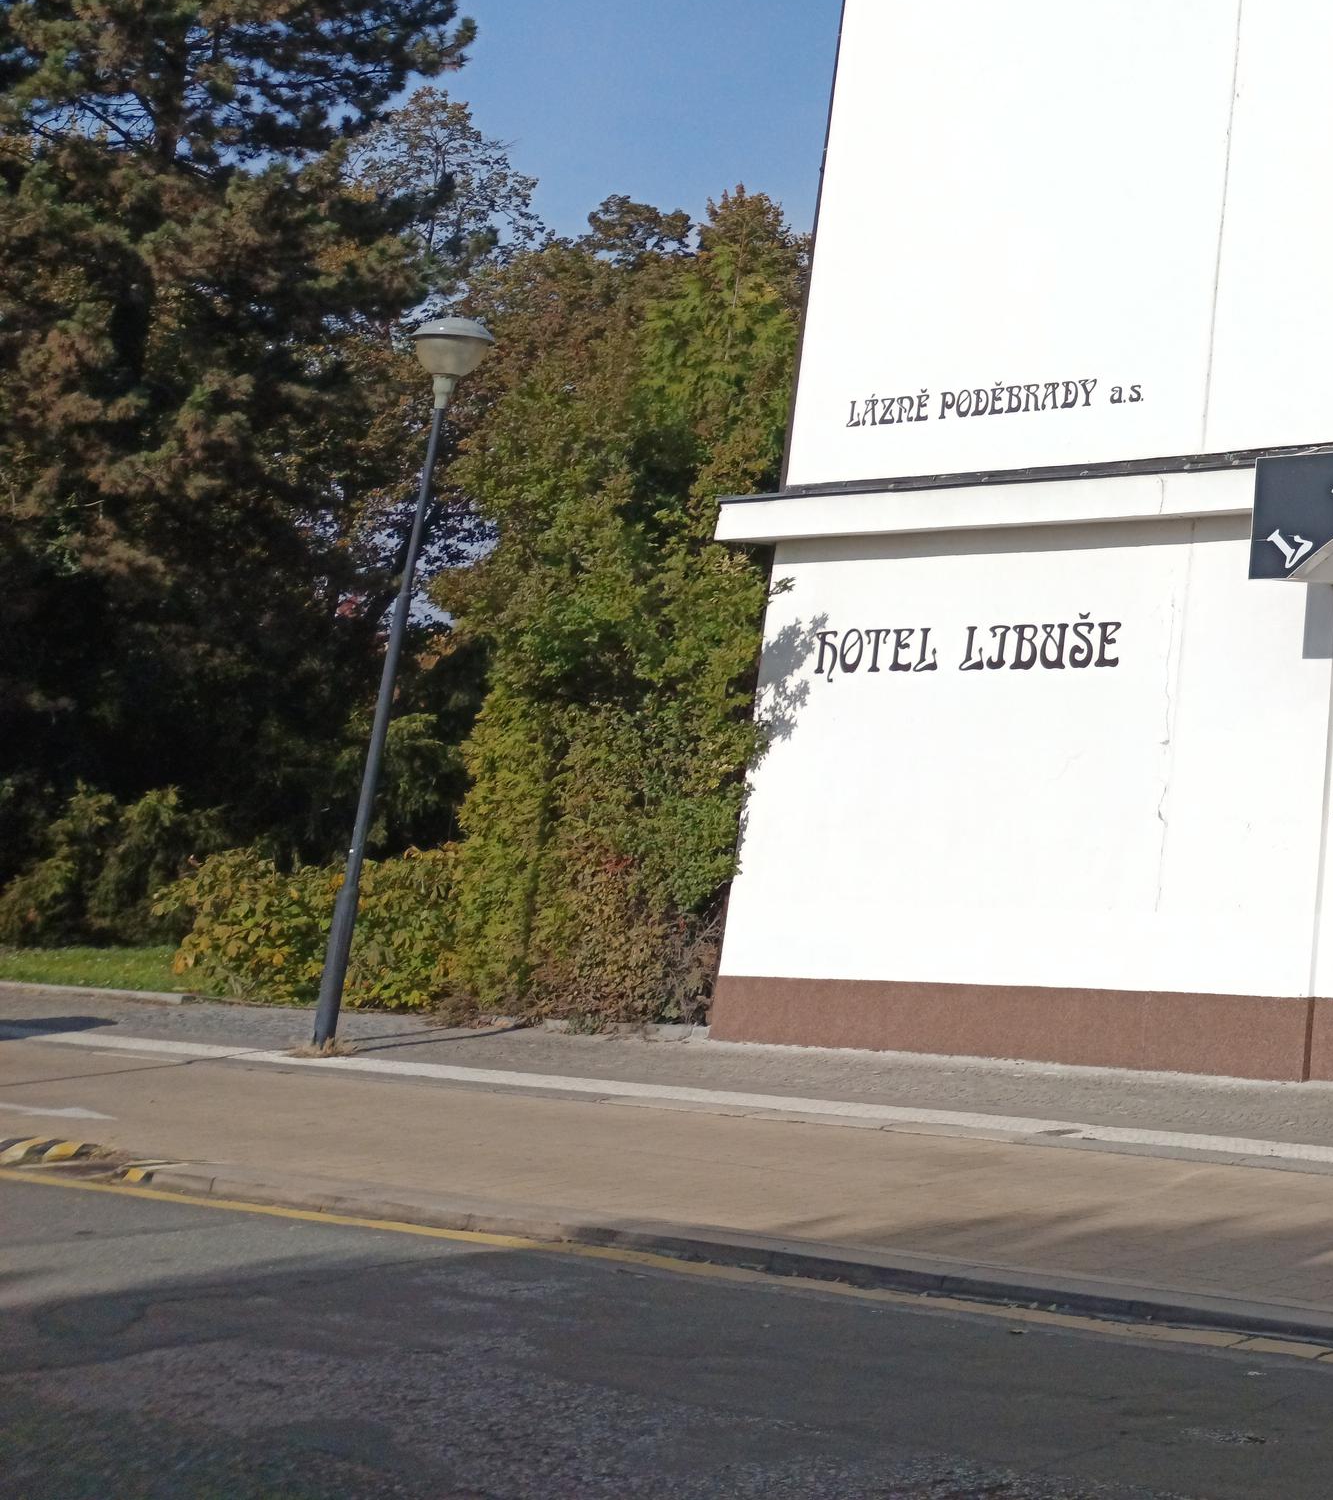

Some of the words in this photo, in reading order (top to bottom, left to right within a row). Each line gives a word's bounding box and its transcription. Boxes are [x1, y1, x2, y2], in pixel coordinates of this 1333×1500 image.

[845, 387, 930, 428] LÁZNĚ
[938, 378, 1098, 420] PODĚBRADY
[1109, 384, 1145, 405] a.s.
[813, 627, 939, 683] HOTEL
[958, 611, 1122, 672] LIBUŠE
